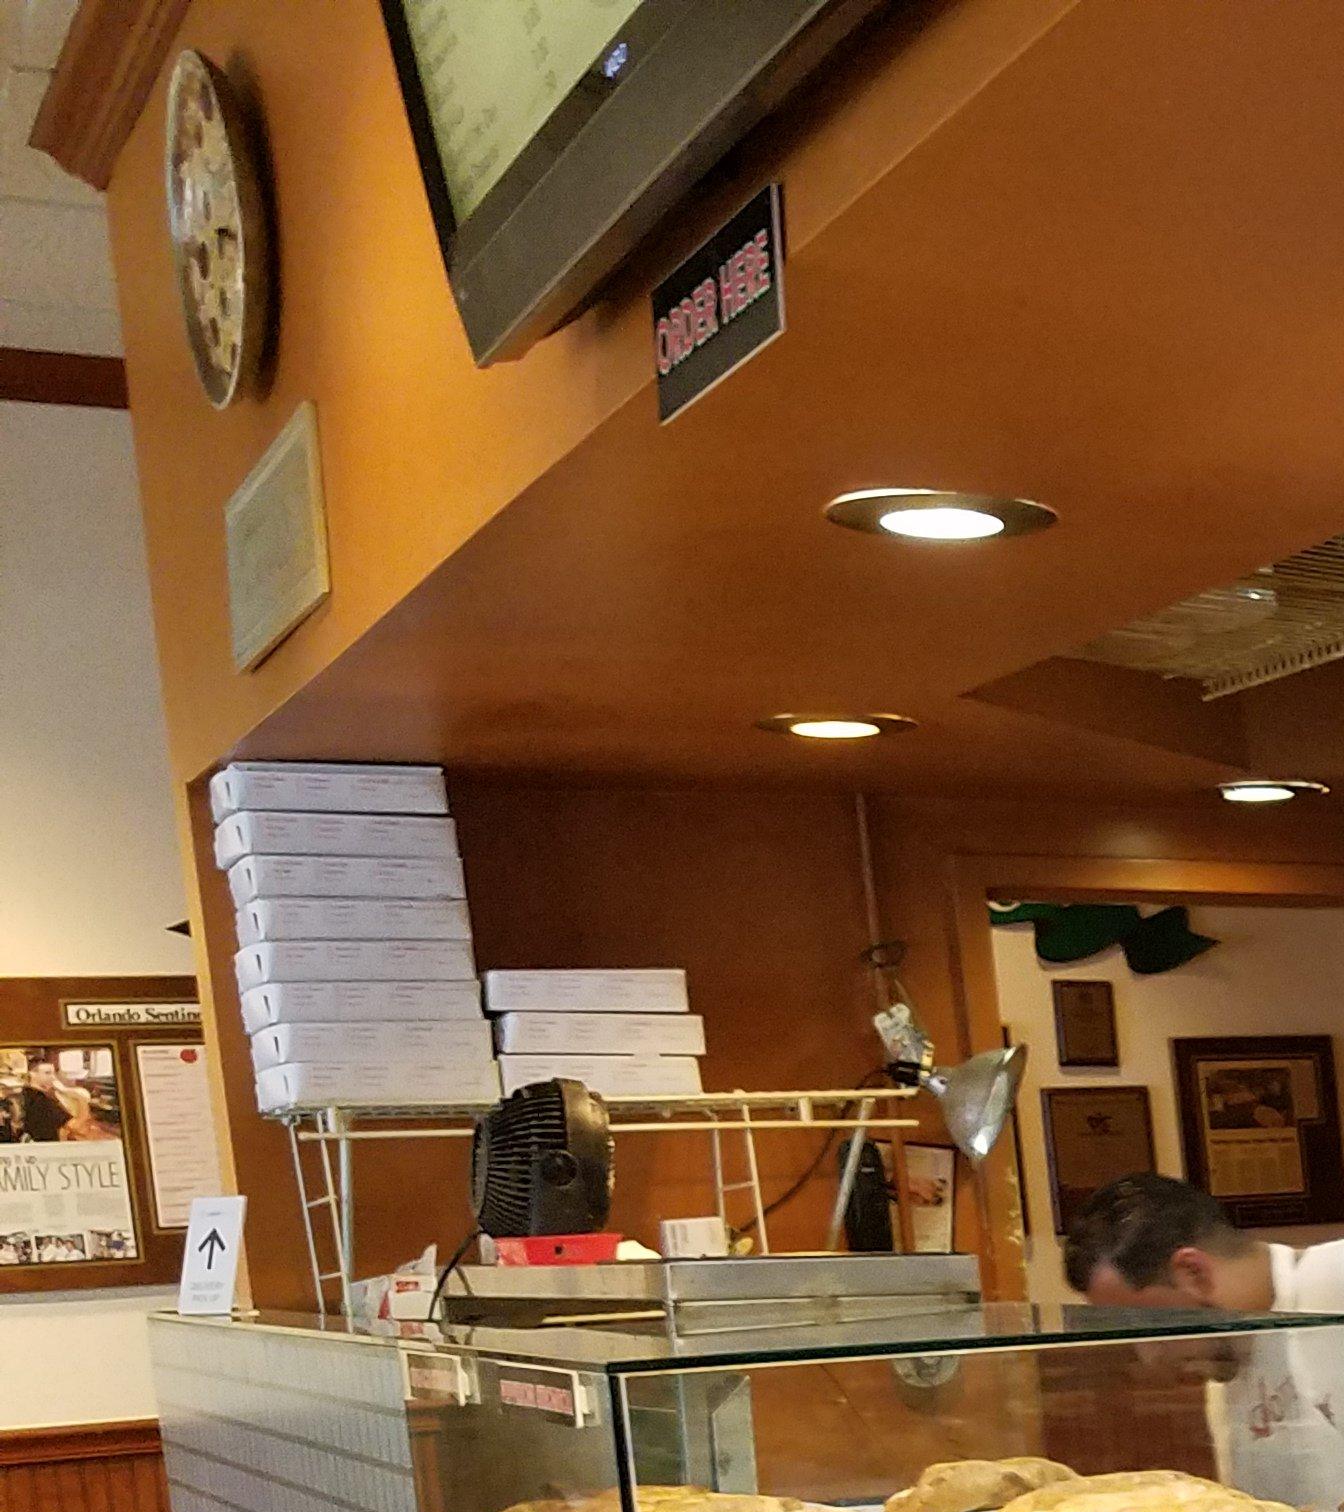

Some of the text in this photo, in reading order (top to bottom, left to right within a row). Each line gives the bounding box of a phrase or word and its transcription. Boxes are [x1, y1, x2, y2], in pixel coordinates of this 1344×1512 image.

[656, 228, 771, 375] ORDER HERE
[75, 1006, 141, 1024] Orlando
[58, 1161, 121, 1191] STYLE
